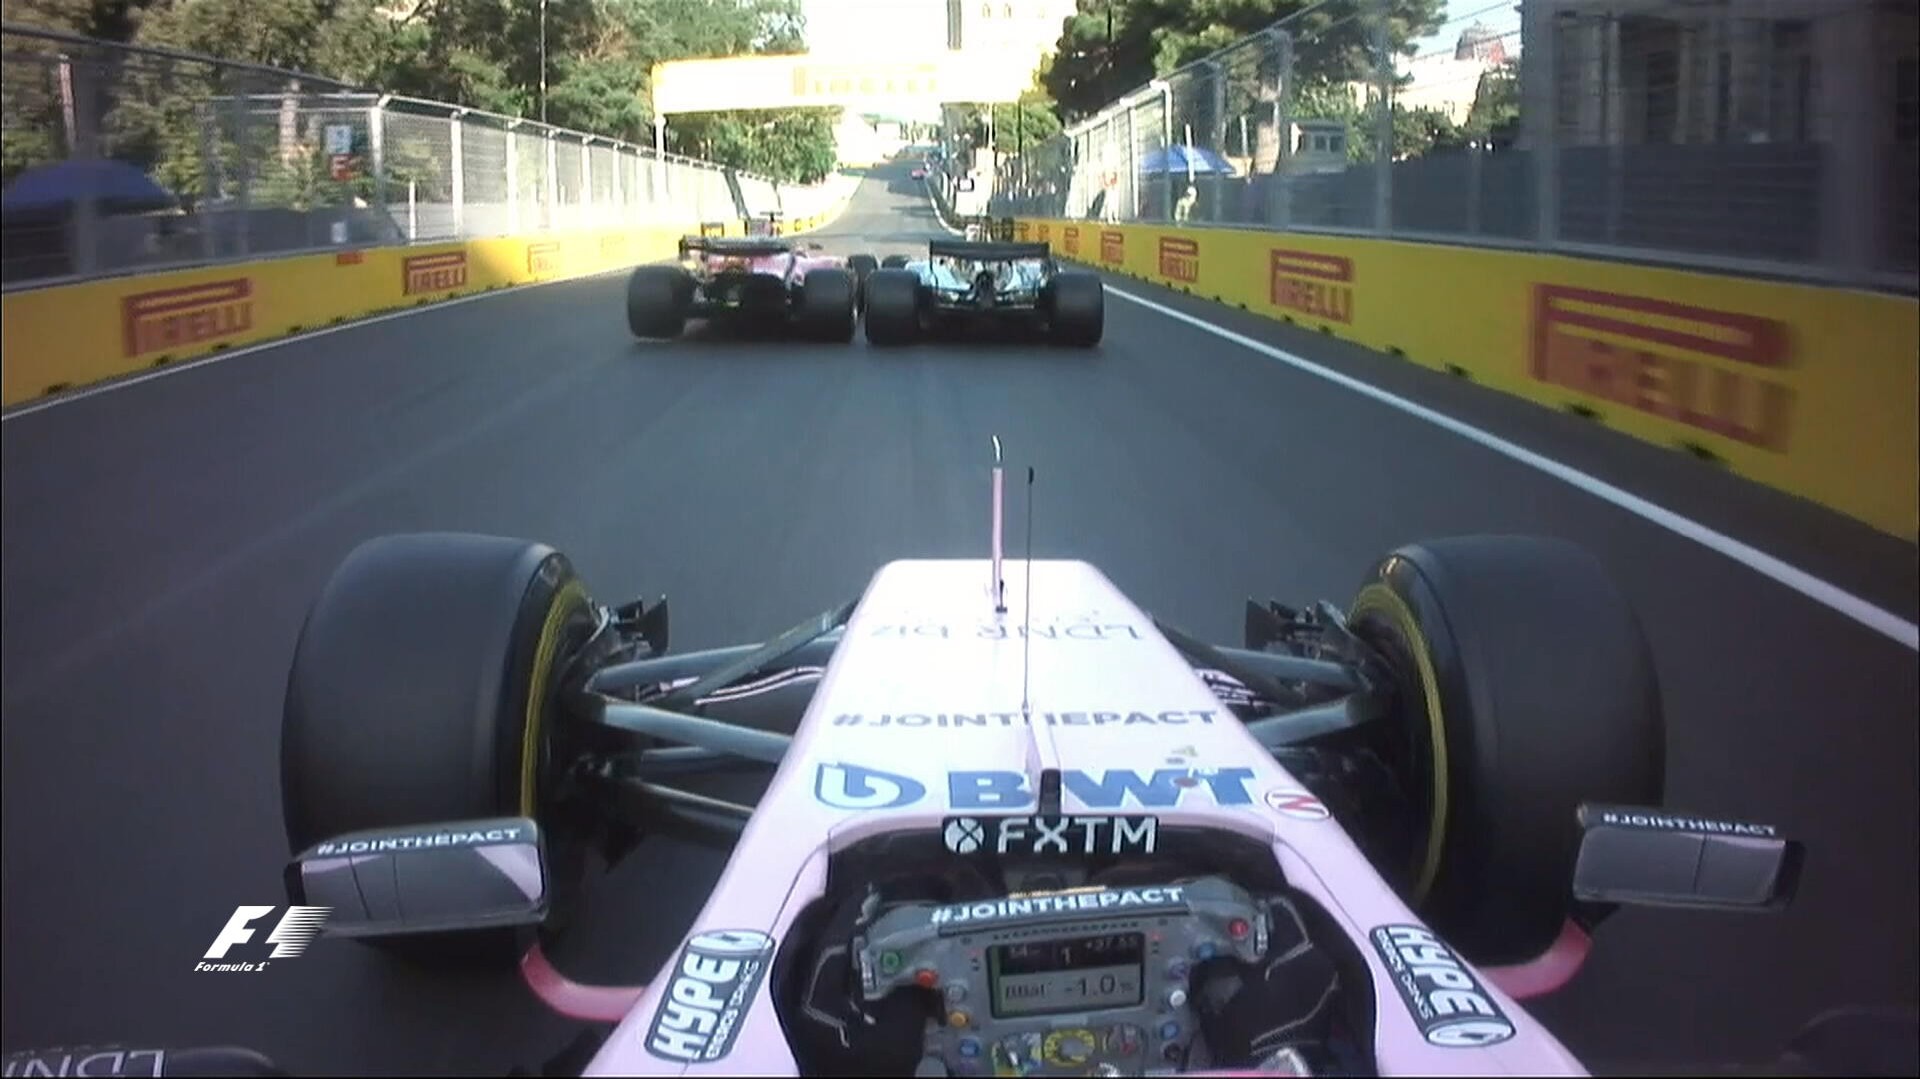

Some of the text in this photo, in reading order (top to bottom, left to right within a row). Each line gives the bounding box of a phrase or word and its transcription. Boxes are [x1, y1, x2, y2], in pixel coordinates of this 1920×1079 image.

[1270, 248, 1354, 325] PIRELLI
[317, 828, 521, 855] #JOINTHEPACT
[997, 818, 1157, 855] FXTM
[1603, 812, 1776, 836] #JOINTHEPACT
[931, 888, 1186, 924] #JOINTHEPACT
[1387, 926, 1495, 1017] HYPE
[652, 953, 740, 1059] HYPE
